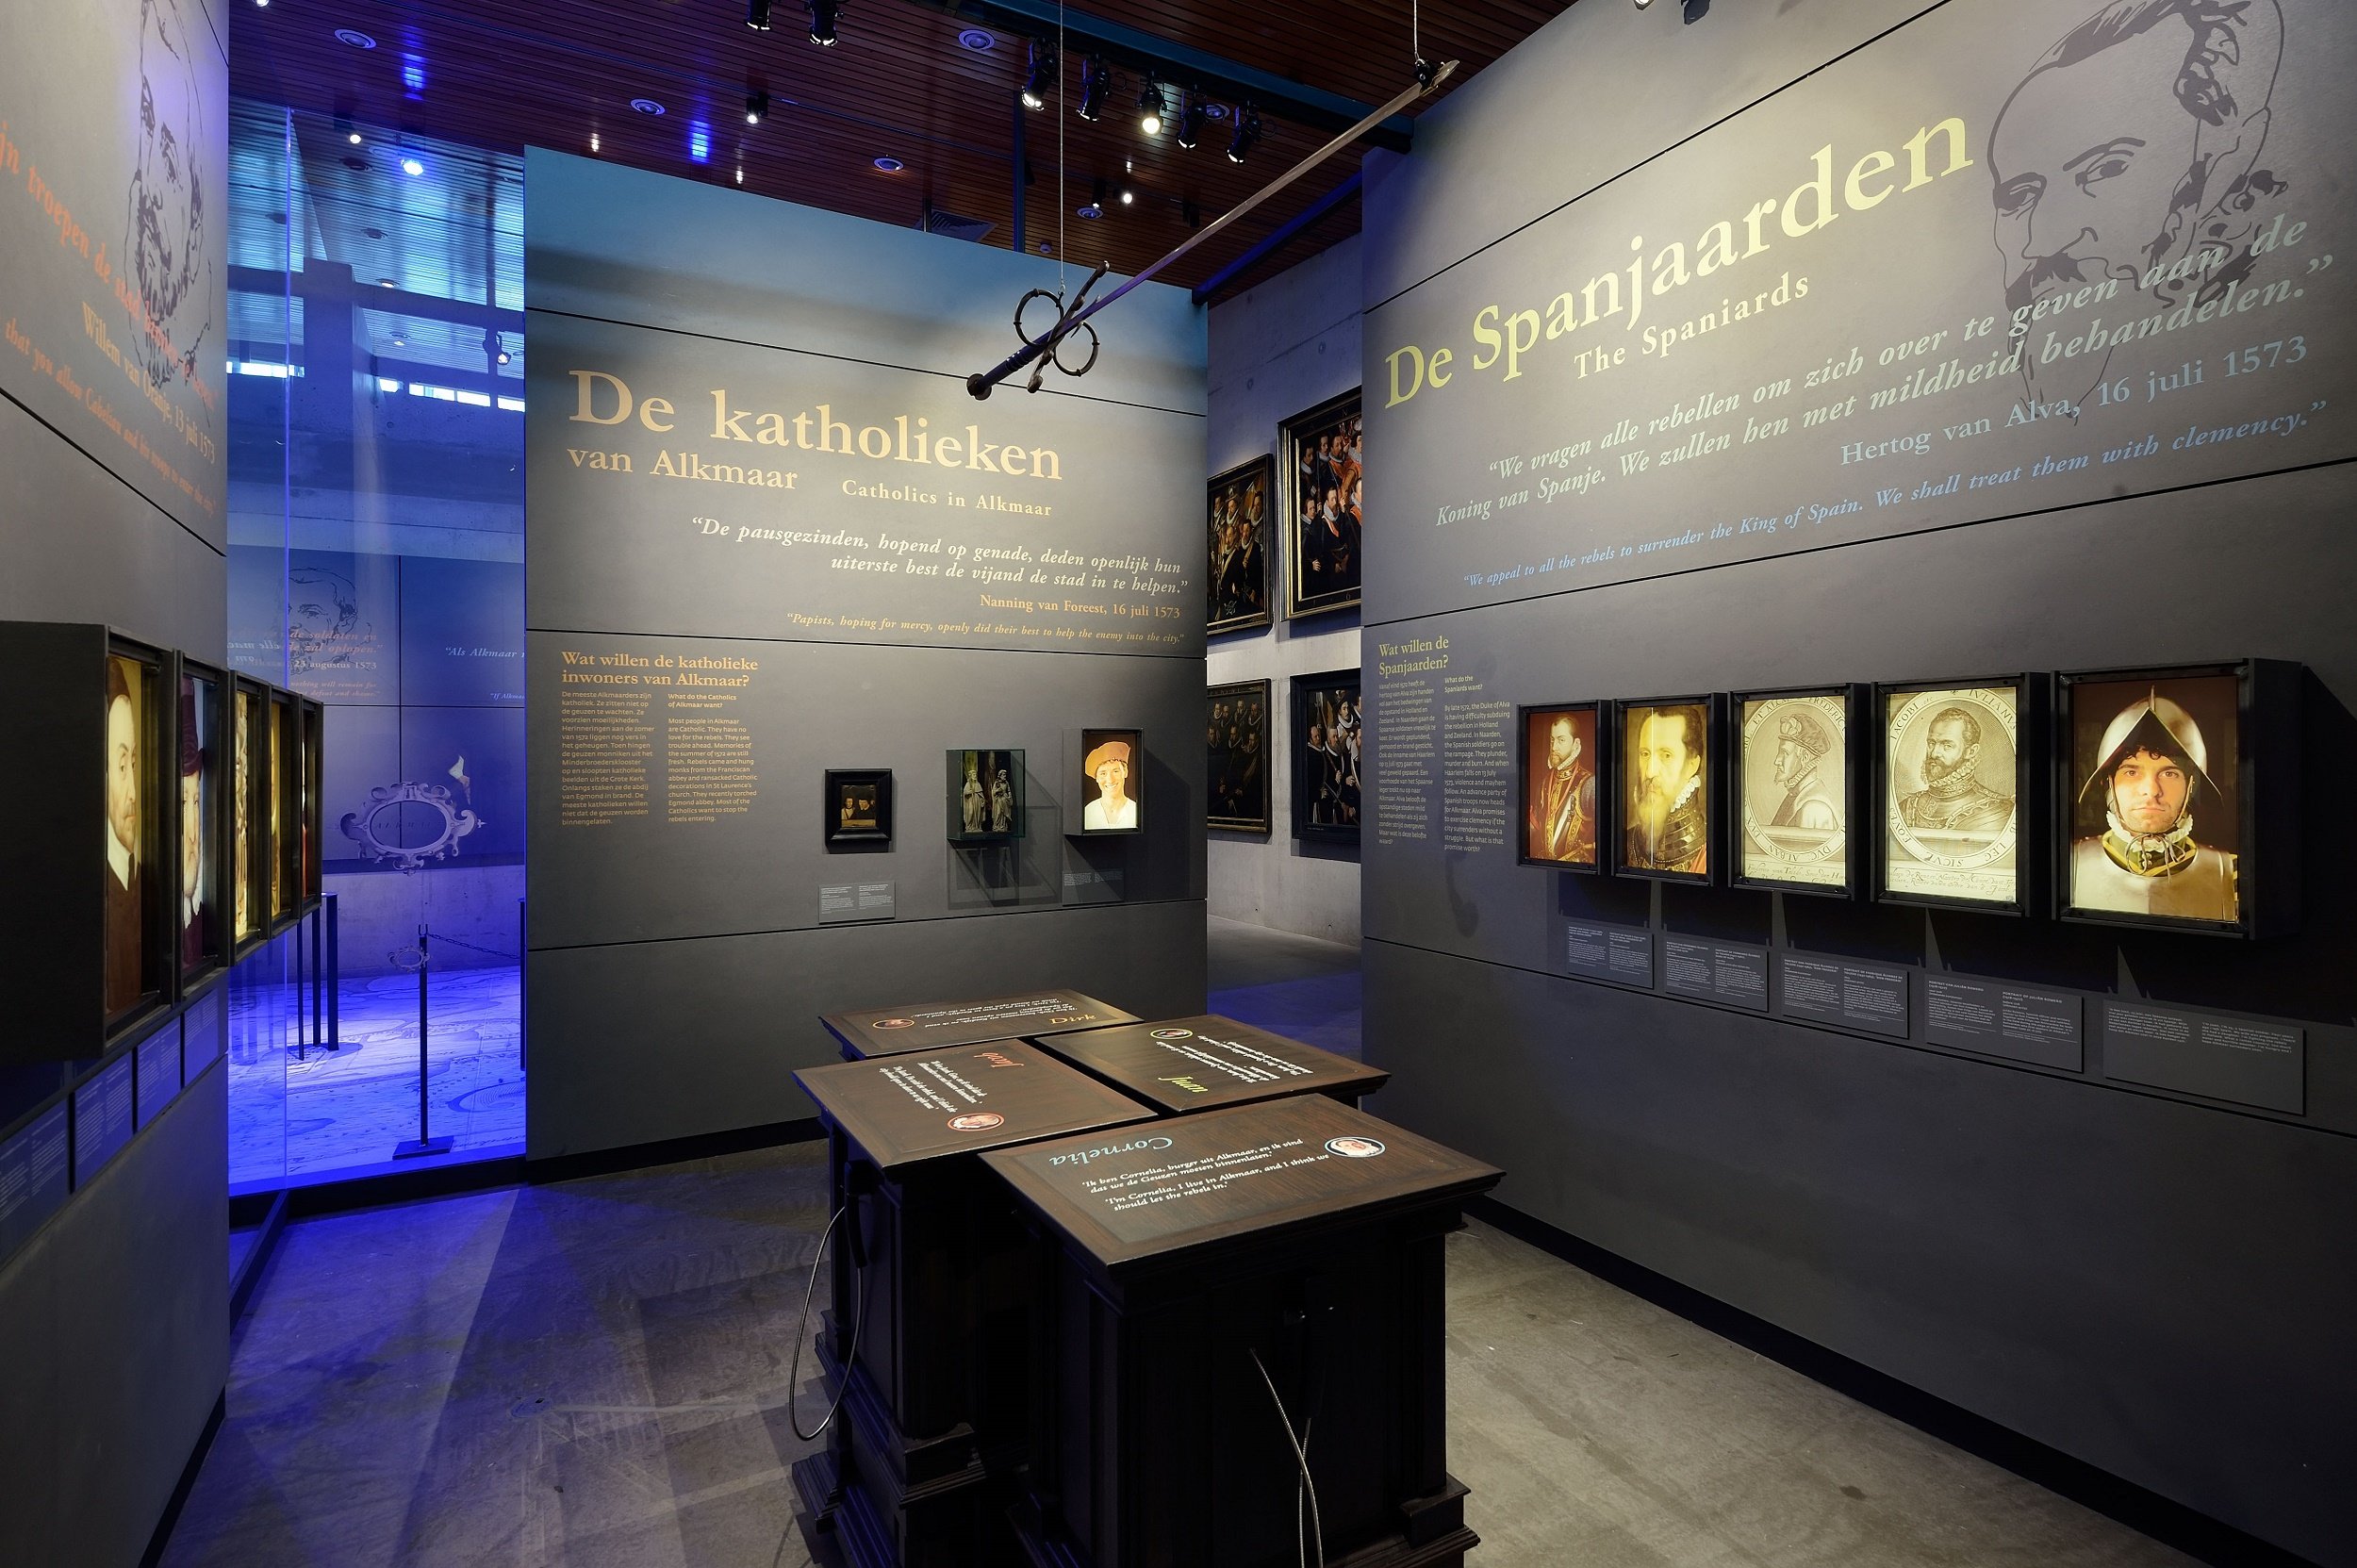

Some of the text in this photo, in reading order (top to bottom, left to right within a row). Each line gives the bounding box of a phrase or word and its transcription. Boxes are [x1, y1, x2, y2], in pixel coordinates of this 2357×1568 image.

[27, 166, 111, 285] troepen de
[1386, 118, 1973, 408] De Spanjaarden
[1574, 272, 1808, 379] The Spaniards
[1490, 213, 2307, 479] “We vragen alle rebellen om zich over te geven aan de
[82, 302, 215, 462] Willem van Oranje, 13 juli 1573
[1436, 255, 2332, 526] Koning van Spanje. We zullen hen met mildheid behandelen.”
[1840, 336, 2306, 465] Hertog van Alva, 16 juli 1573
[569, 371, 1062, 480] De katholieken
[567, 449, 798, 488] van Alkmaar
[843, 480, 1051, 516] Catholics in Alkmaar
[1487, 565, 1521, 586] appeal
[1525, 567, 1534, 575] to
[1540, 558, 1555, 572] all
[1559, 554, 1575, 569] the
[1581, 546, 1614, 564] rebels
[1621, 547, 1632, 556] to
[1638, 530, 1704, 553] surrender
[1710, 523, 1732, 539] the
[1739, 517, 1777, 534] King
[1785, 506, 1805, 528] of
[1808, 499, 1862, 524] Spain.
[1876, 487, 1903, 506] We
[1911, 474, 1961, 500] shall
[1970, 467, 2021, 488] treat
[2032, 455, 2088, 481] them
[2102, 435, 2158, 463] with
[693, 517, 1180, 574] “De pausgezinden, hopend op genade, deden openlijk hun
[832, 555, 1188, 596] uiterste best de vijand de stad in te helpen.”
[981, 595, 1033, 613] Nanning
[1064, 601, 1107, 615] Foreest,
[1113, 603, 1126, 615] 16
[1130, 605, 1148, 619] juli
[1156, 607, 1179, 618] 1573
[840, 616, 877, 630] hoping
[879, 619, 897, 630] for
[901, 622, 932, 632] mercy,
[938, 622, 969, 634] openly
[974, 623, 991, 632] did
[995, 624, 1017, 634] their
[1022, 626, 1039, 635] best
[1056, 628, 1075, 639] help
[1079, 629, 1092, 637] the
[1096, 633, 1123, 641] enemy
[1127, 632, 1143, 640] into
[1147, 633, 1160, 641] the
[470, 648, 517, 658] Alkmaar
[562, 652, 758, 669] Wat willen de katholieke
[1379, 635, 1448, 656] Wat willen de
[562, 669, 749, 686] inwoners van Alkmaar?
[1379, 654, 1448, 679] Spanjaarden?
[1444, 685, 1467, 694] Spaniards
[1049, 1013, 1096, 1025] Dirk
[1158, 1075, 1208, 1093] Juan
[1049, 1137, 1173, 1166] Cornelia
[1120, 1168, 1165, 1179] Cornelia,
[1167, 1162, 1197, 1170] burger
[1217, 1149, 1258, 1161] Alkmaar,
[1141, 1172, 1178, 1182] Geuzen
[1179, 1165, 1213, 1175] moeten
